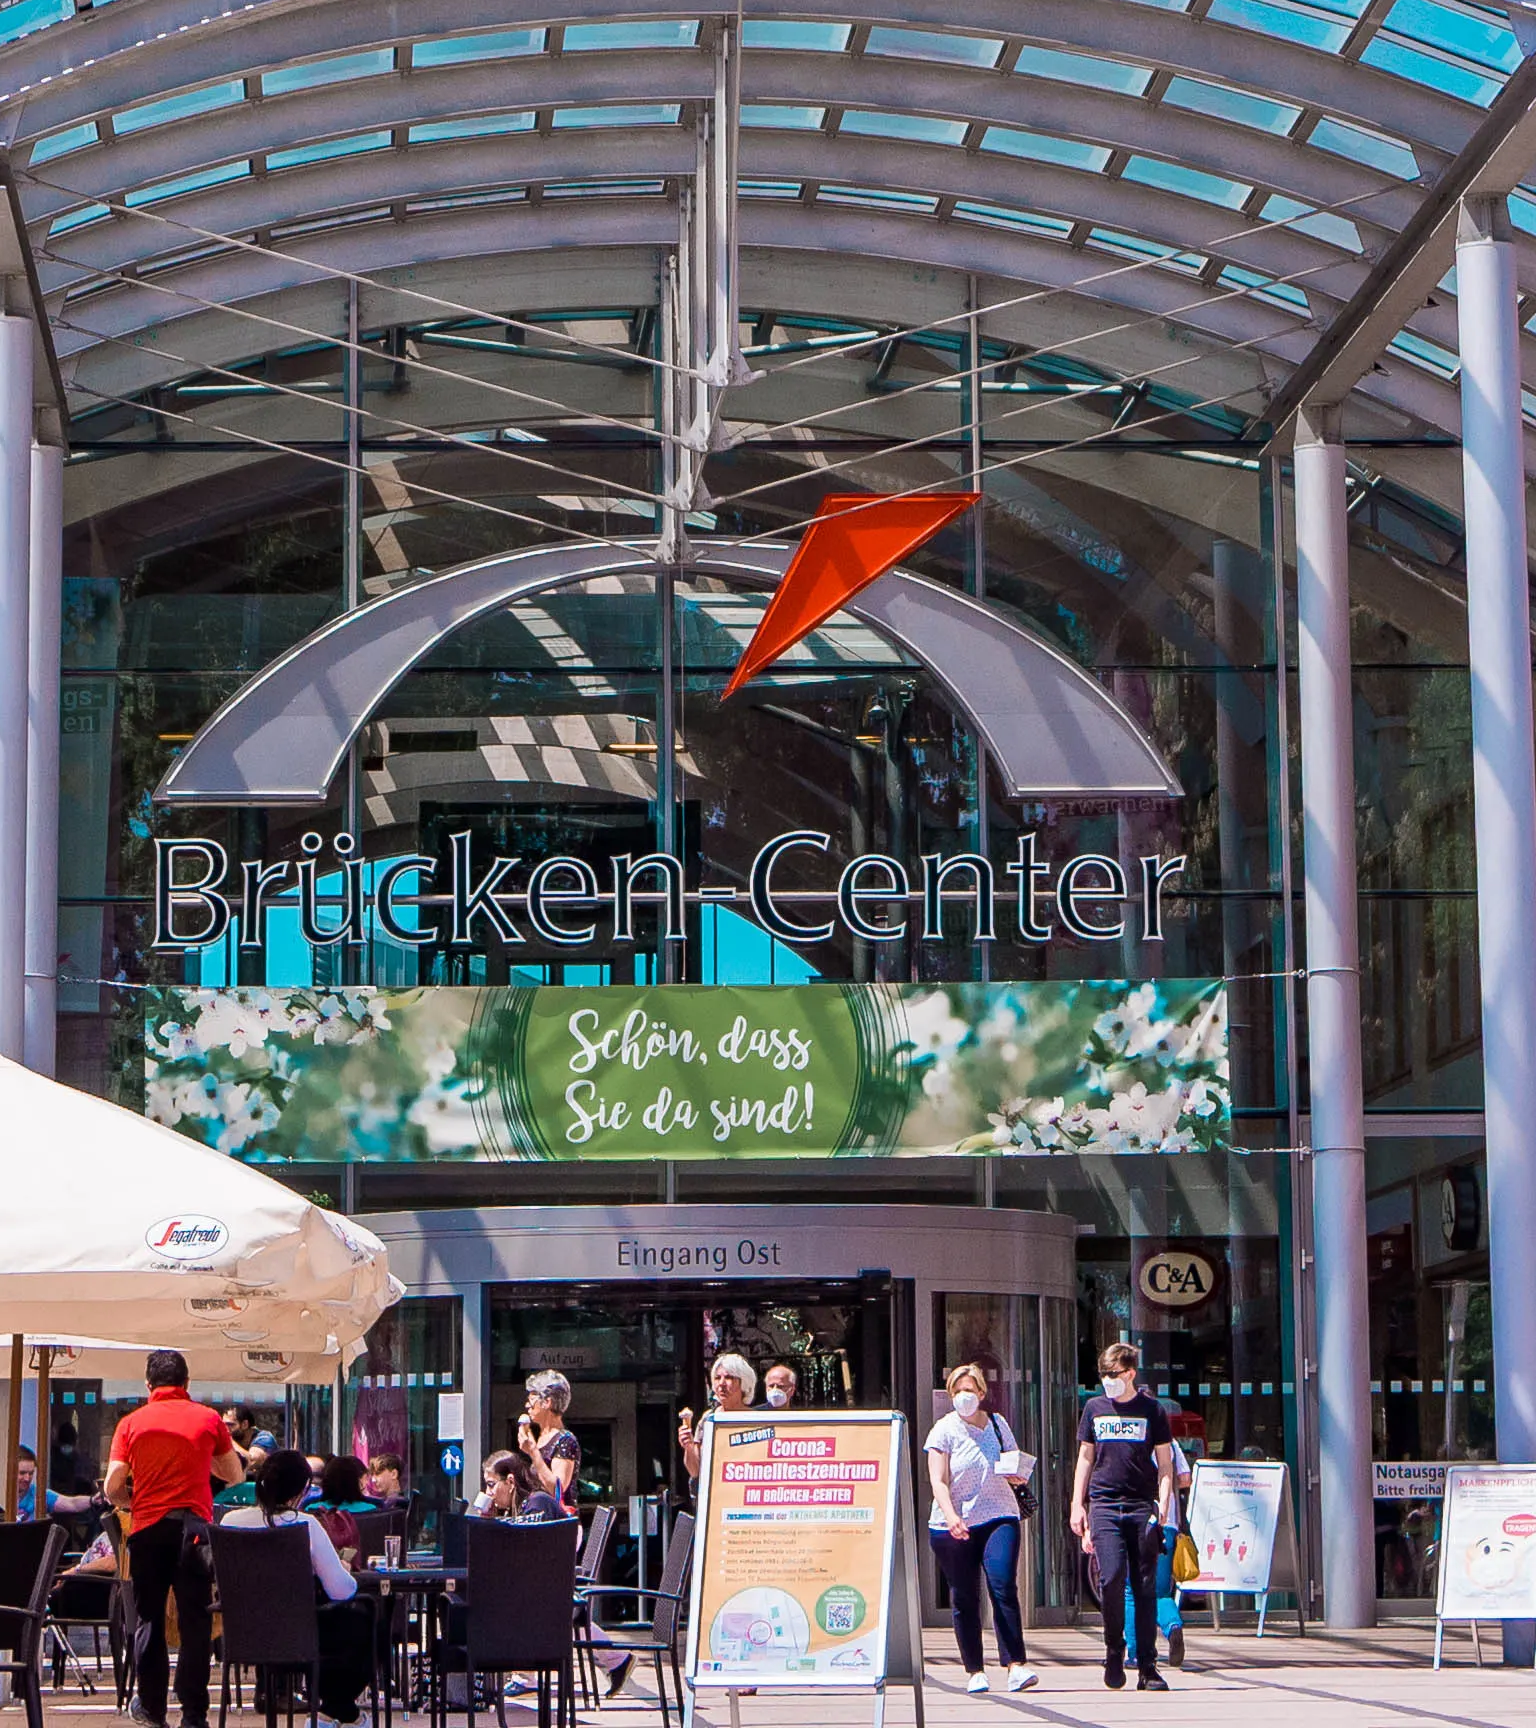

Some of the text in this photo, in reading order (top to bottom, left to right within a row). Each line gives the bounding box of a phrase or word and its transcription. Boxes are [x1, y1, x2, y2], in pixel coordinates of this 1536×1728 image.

[151, 828, 1185, 949] Brücken-Center
[568, 1008, 813, 1073] Schön, dass
[565, 1079, 814, 1144] Sie da sind!
[154, 1221, 222, 1247] Segafredo
[617, 1239, 782, 1272] Eingang Ost
[1147, 1262, 1207, 1294] C&A
[539, 1352, 585, 1366] Aufzug
[1099, 1420, 1134, 1436] snipes
[771, 1439, 832, 1457] Corona-
[725, 1462, 876, 1481] Schnelltestzentrum
[1376, 1464, 1446, 1482] Notausga
[746, 1485, 852, 1503] IM BRÜCKEN-CENTER
[1377, 1484, 1405, 1496] Bitte
